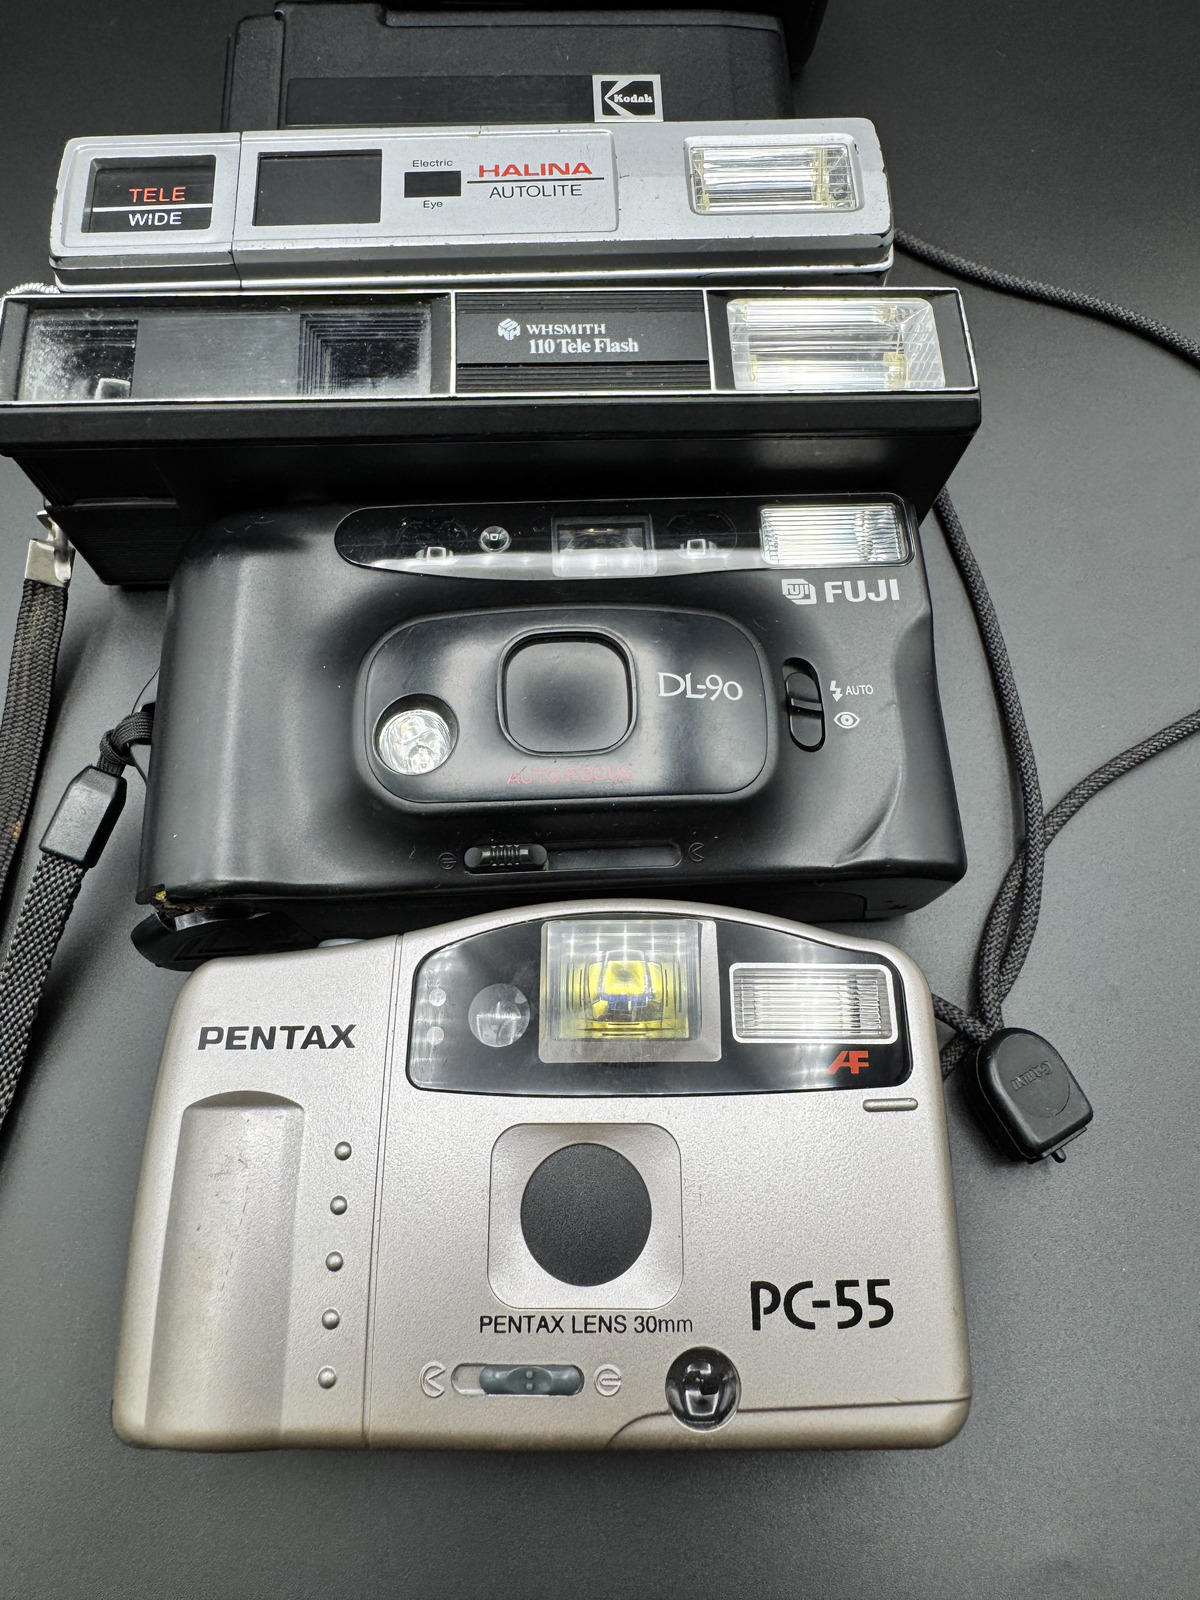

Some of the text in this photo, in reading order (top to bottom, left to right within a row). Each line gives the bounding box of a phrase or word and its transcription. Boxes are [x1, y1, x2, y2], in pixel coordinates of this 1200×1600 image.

[613, 93, 654, 104] Kodak
[412, 159, 453, 168] Electric
[479, 163, 592, 178] HALINA
[129, 186, 186, 203] TELE
[490, 185, 582, 199] AUTOLITE
[423, 200, 443, 210] Eye
[129, 211, 183, 227] WIDE
[526, 323, 606, 335] WHSMITH
[528, 337, 639, 354] 110 Tele Flash
[824, 579, 900, 603] FUJI
[657, 671, 743, 701] DL-90
[845, 684, 874, 696] AUTO
[507, 765, 635, 785] AUTO FOCUS
[198, 1024, 356, 1050] PENTAX
[827, 1050, 870, 1074] AF
[751, 1279, 894, 1331] PC-55
[480, 1315, 693, 1334] PENTAX LENS 30mm
